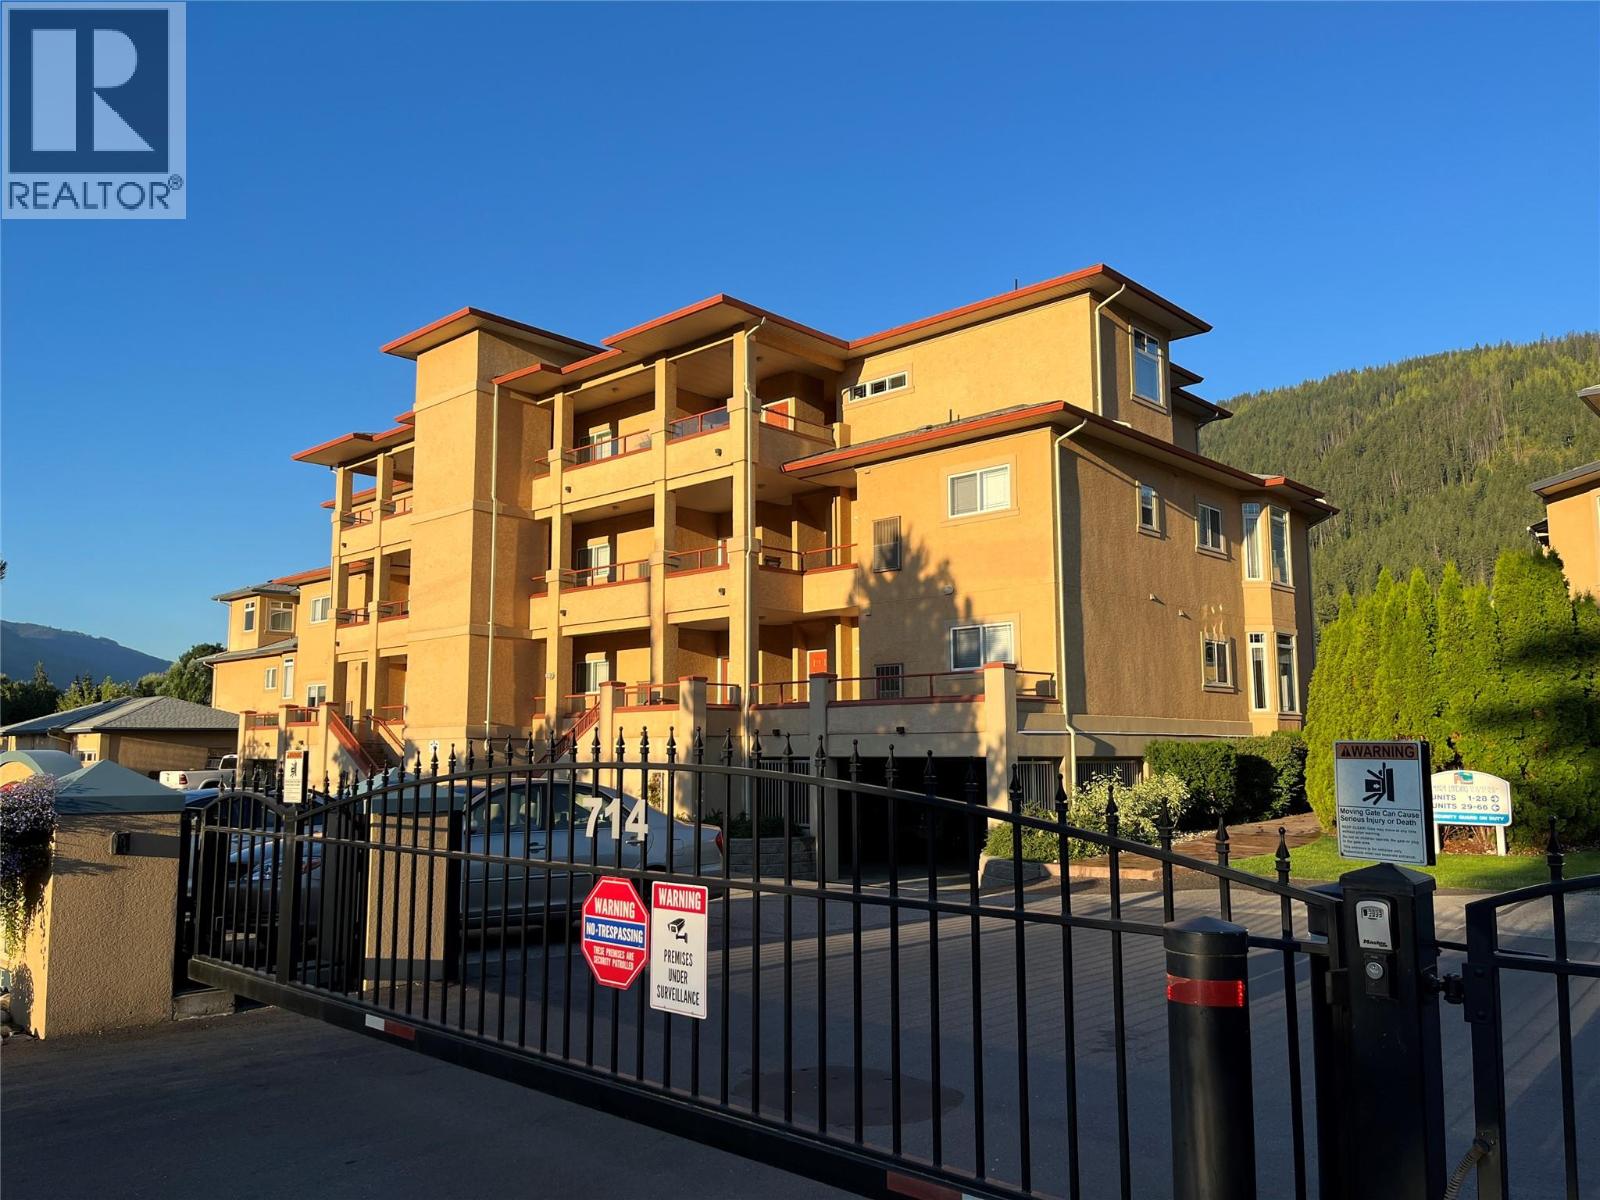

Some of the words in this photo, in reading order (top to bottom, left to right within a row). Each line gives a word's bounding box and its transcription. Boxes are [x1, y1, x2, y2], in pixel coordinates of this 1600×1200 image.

[1350, 745, 1415, 758] WARNING
[582, 797, 649, 841] 714
[1340, 807, 1364, 817] Moving
[1365, 808, 1381, 816] Gate
[1382, 809, 1396, 817] Can
[1397, 810, 1420, 818] Cause
[1340, 815, 1365, 823] Serious
[1366, 816, 1386, 825] Injury
[1396, 818, 1417, 826] Death
[594, 897, 636, 919] WARNING
[658, 887, 702, 911] WARNING
[663, 949, 693, 967] PREMISES
[668, 967, 688, 985] UNDER
[656, 984, 700, 1006] SURVEILLANCE
